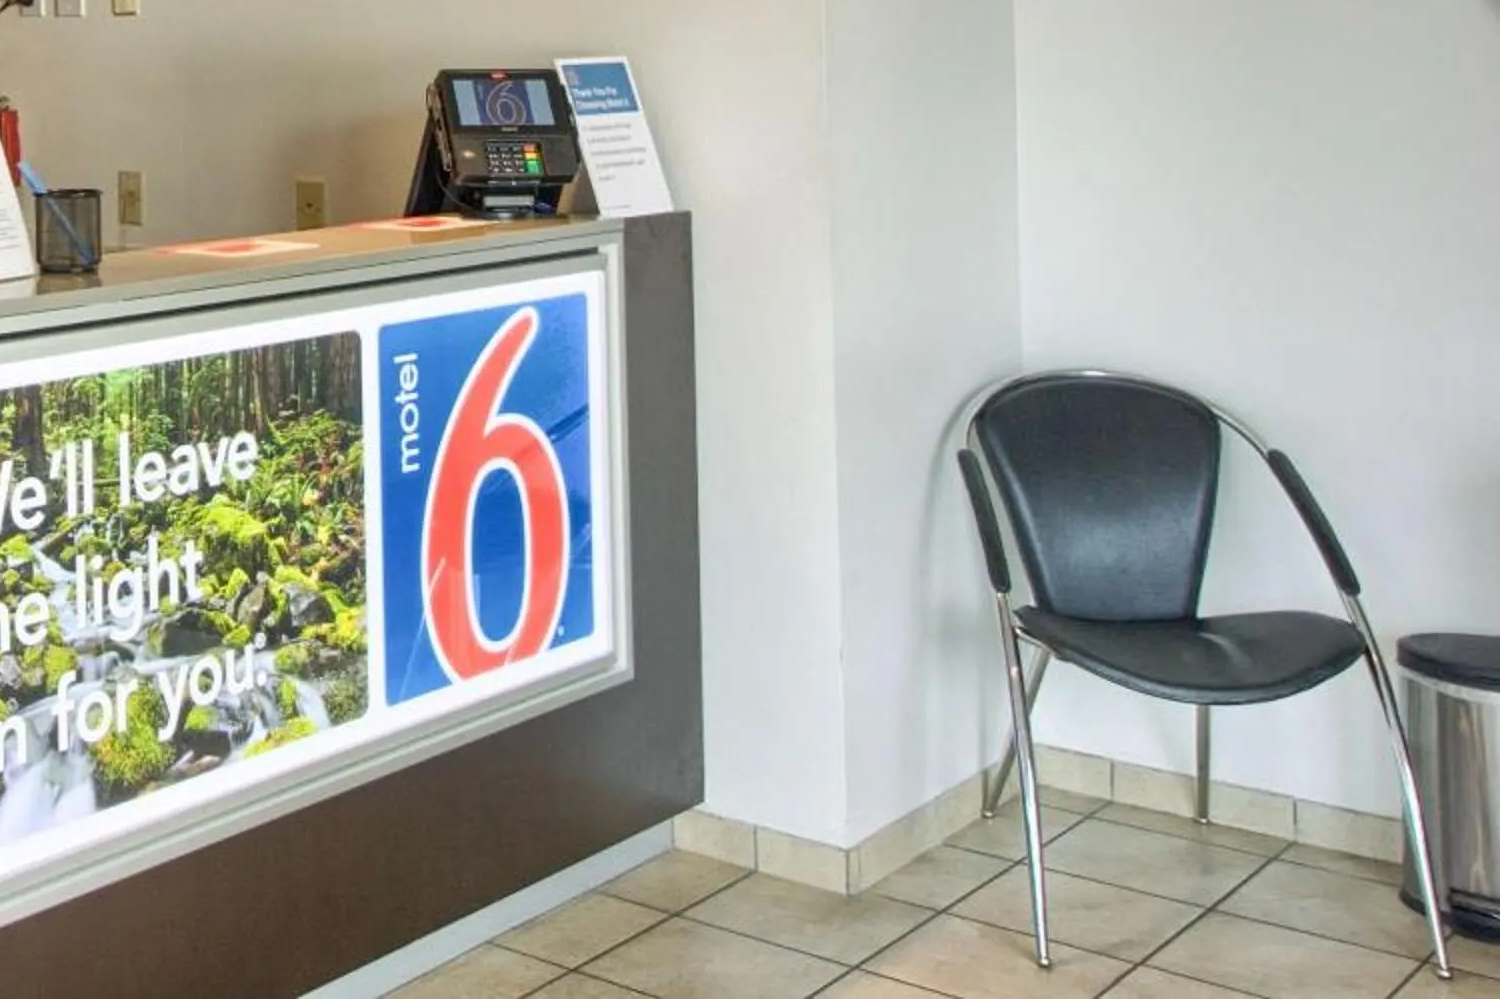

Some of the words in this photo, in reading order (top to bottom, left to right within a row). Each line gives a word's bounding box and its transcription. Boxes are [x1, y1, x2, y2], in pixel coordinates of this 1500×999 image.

[393, 352, 420, 474] motel
[119, 431, 259, 506] leave
[421, 305, 571, 684] 6
[76, 532, 204, 642] light
[52, 670, 139, 752] for
